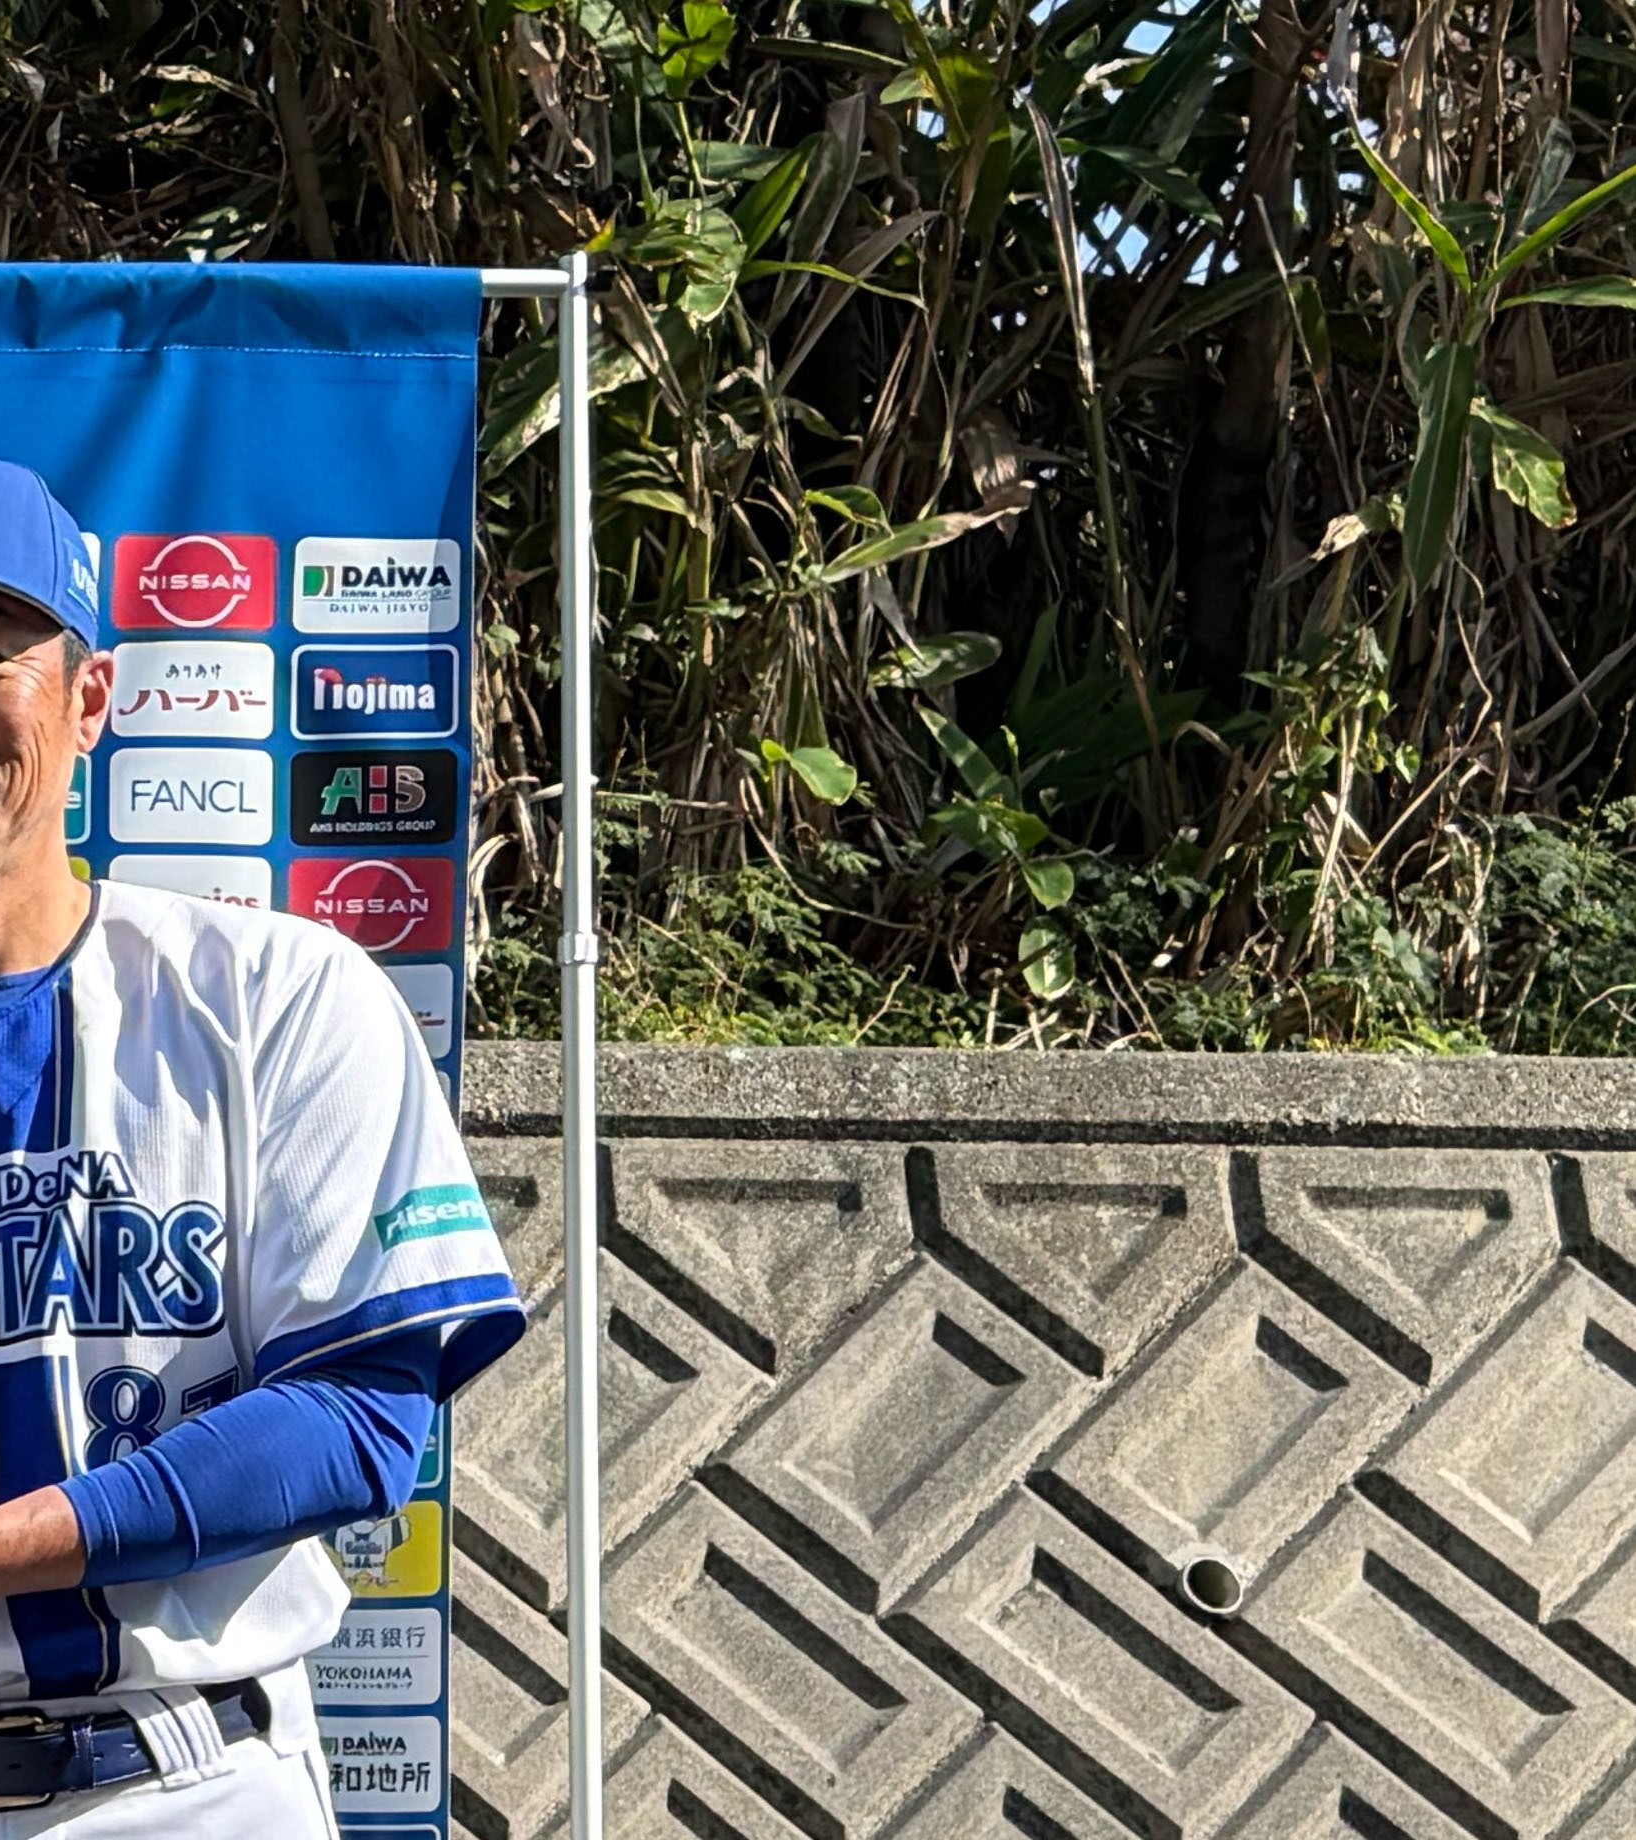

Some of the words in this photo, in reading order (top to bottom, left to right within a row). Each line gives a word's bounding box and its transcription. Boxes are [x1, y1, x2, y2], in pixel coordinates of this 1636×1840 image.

[139, 574, 251, 591] NISSAN
[118, 688, 267, 715] ハーバー
[130, 779, 258, 814] FANCL
[315, 897, 428, 914] NISSAN
[386, 1199, 486, 1242] Hisen
[315, 1666, 412, 1680] YOKOHAMA
[330, 1762, 431, 1792] 和地所
